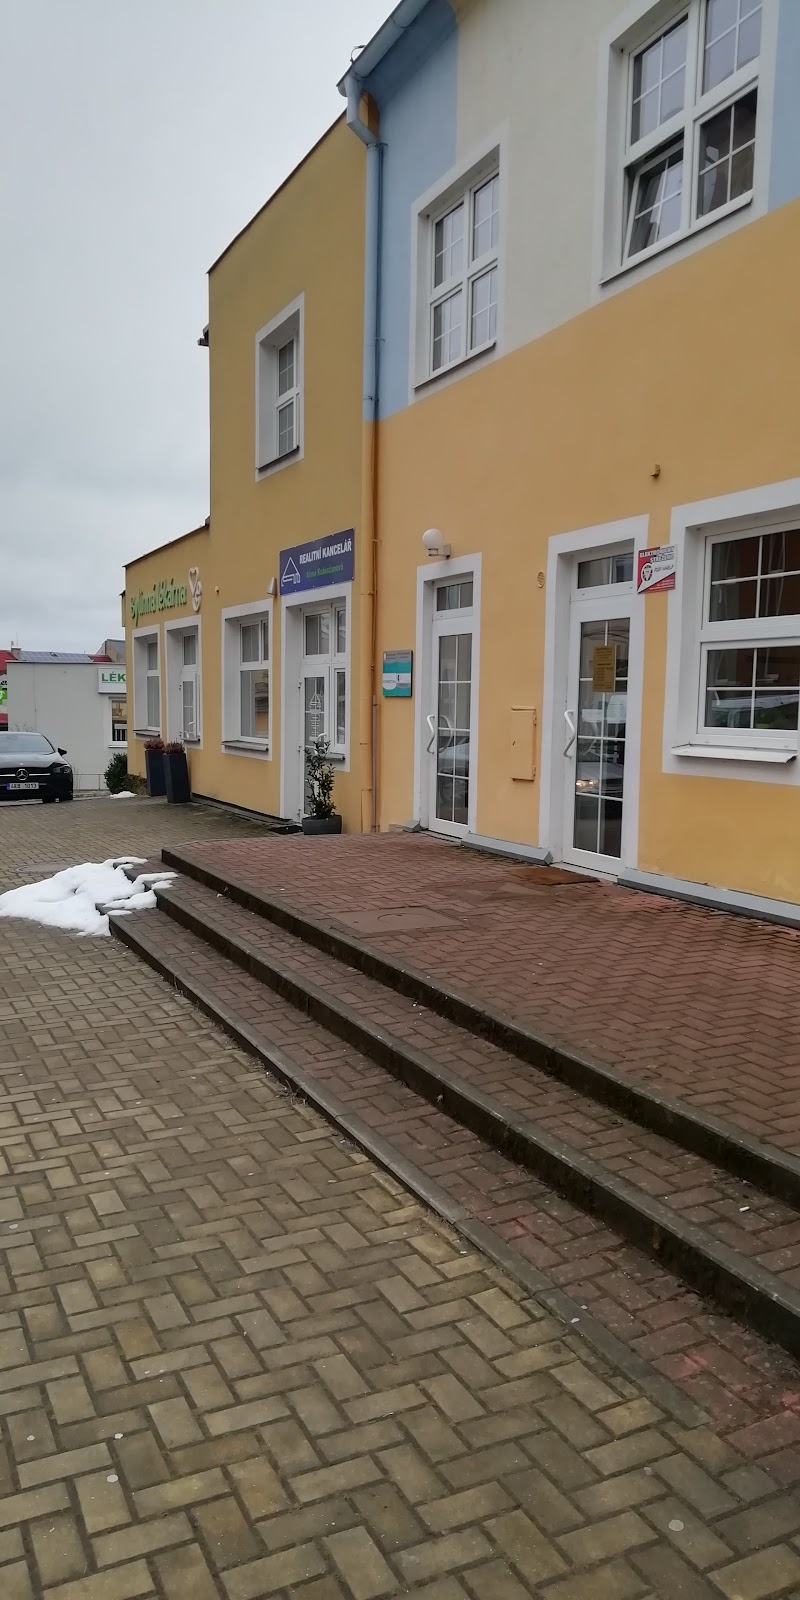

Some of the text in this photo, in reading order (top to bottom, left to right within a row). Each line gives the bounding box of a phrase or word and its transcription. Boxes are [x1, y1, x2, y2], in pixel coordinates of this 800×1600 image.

[299, 538, 352, 565] REALITNÍ KANCELÁŘ
[130, 577, 188, 627] Bylinná lékárna
